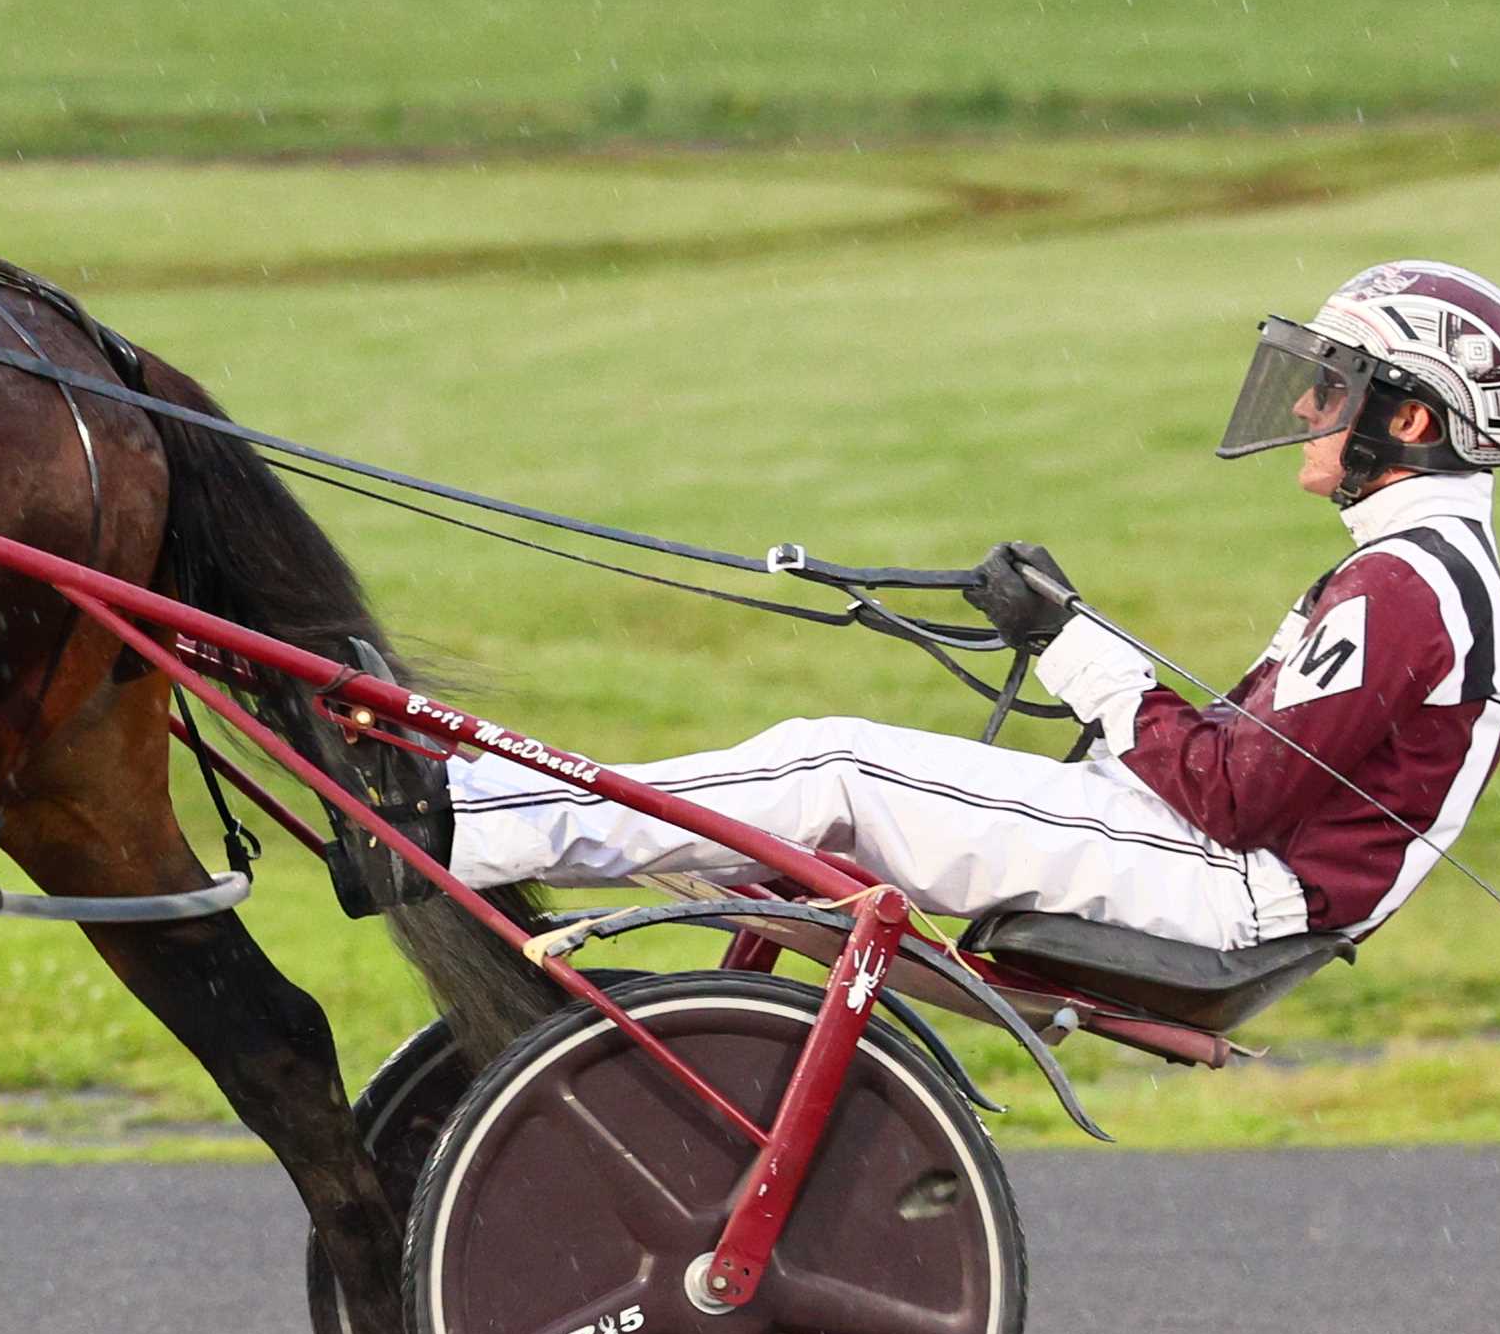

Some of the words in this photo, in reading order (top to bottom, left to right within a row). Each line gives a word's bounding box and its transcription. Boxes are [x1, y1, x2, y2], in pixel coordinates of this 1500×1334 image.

[1287, 624, 1357, 690] M
[474, 720, 600, 783] MacDonald
[619, 1304, 645, 1333] 5
